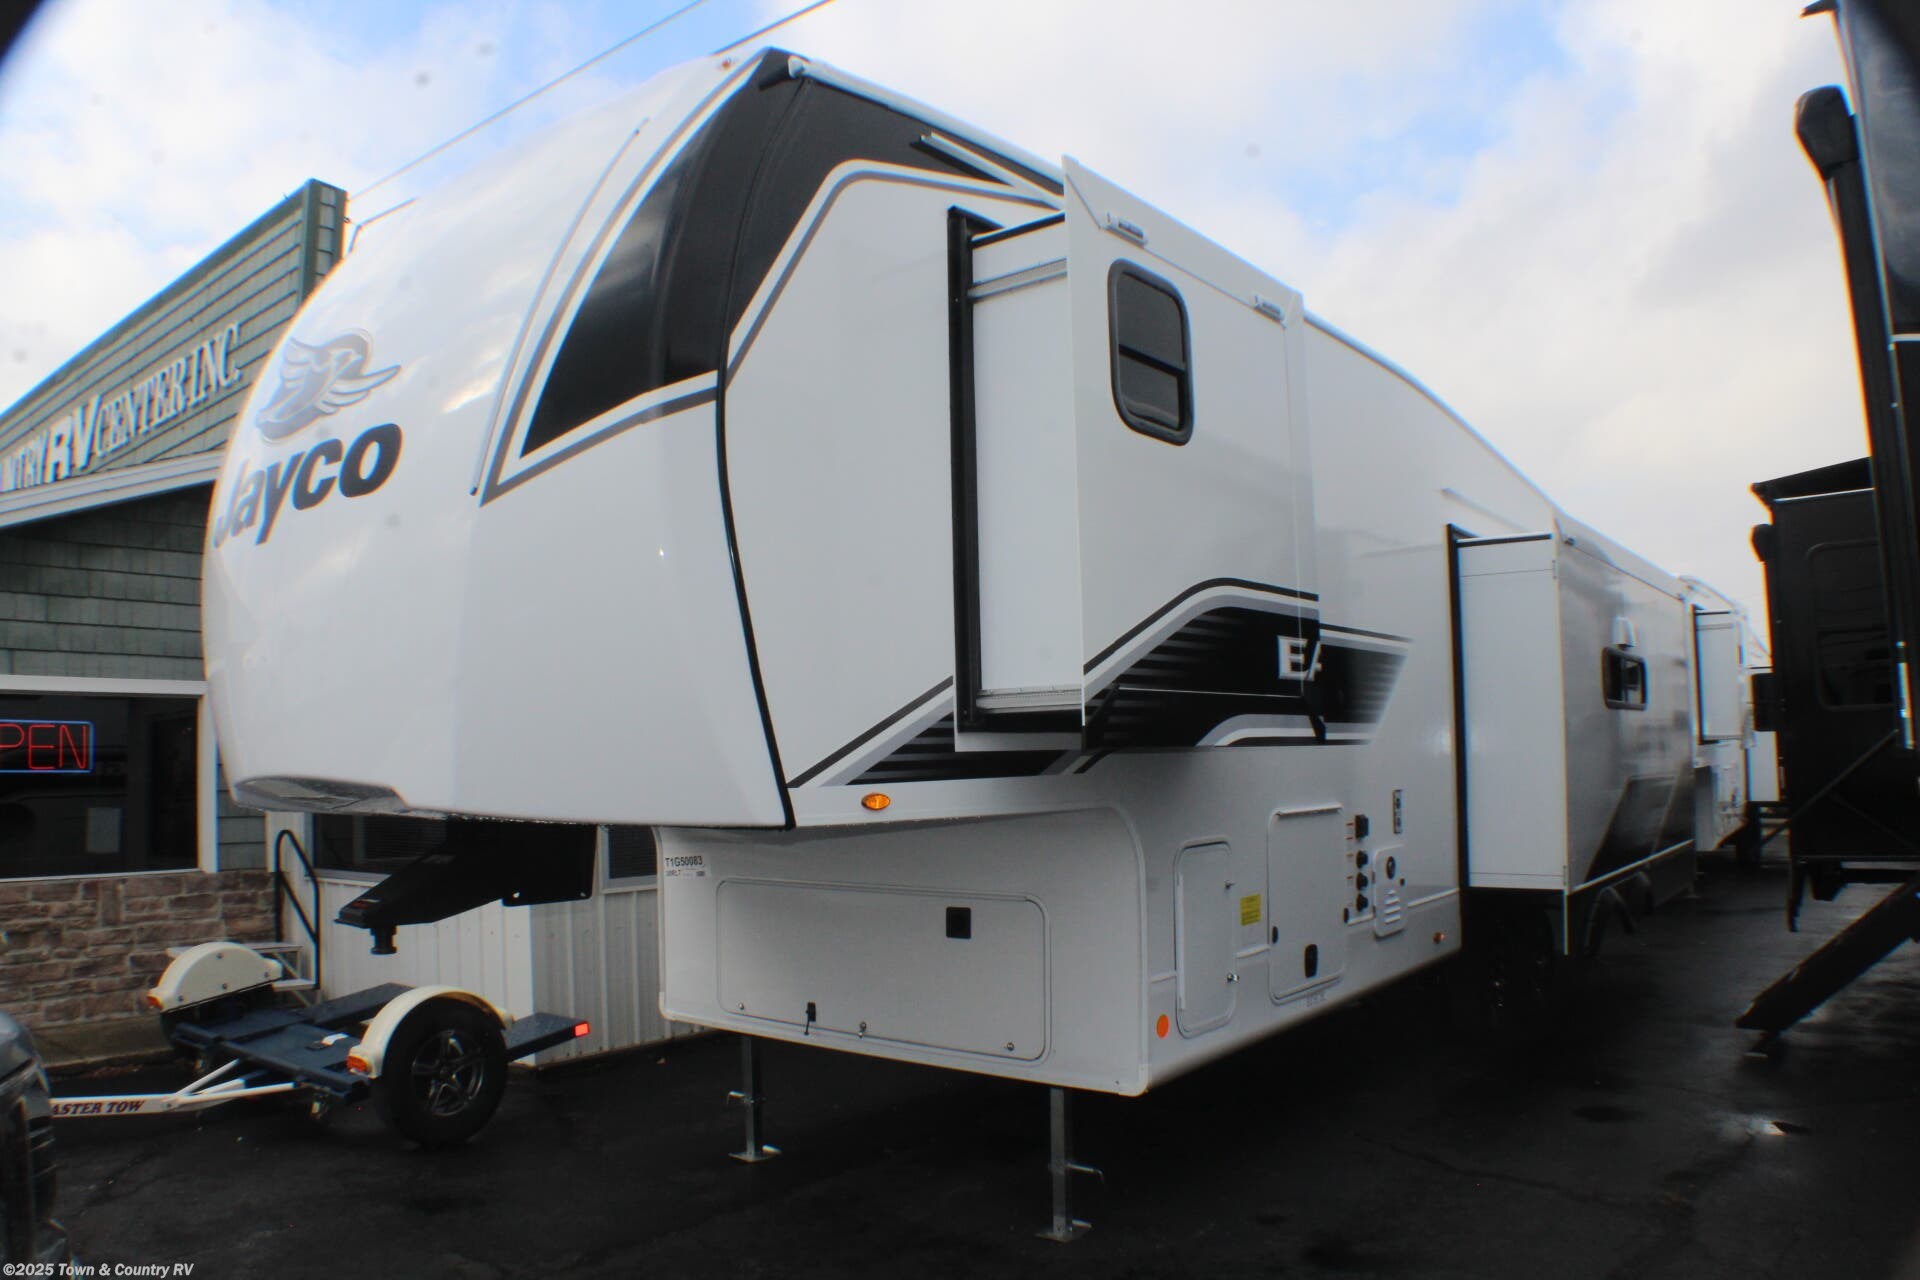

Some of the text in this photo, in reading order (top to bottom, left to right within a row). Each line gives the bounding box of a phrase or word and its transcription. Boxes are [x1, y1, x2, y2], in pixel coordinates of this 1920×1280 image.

[43, 393, 102, 484] RV
[95, 358, 188, 457] CENTER
[212, 422, 403, 549] Jayco
[106, 1100, 145, 1113] TOW
